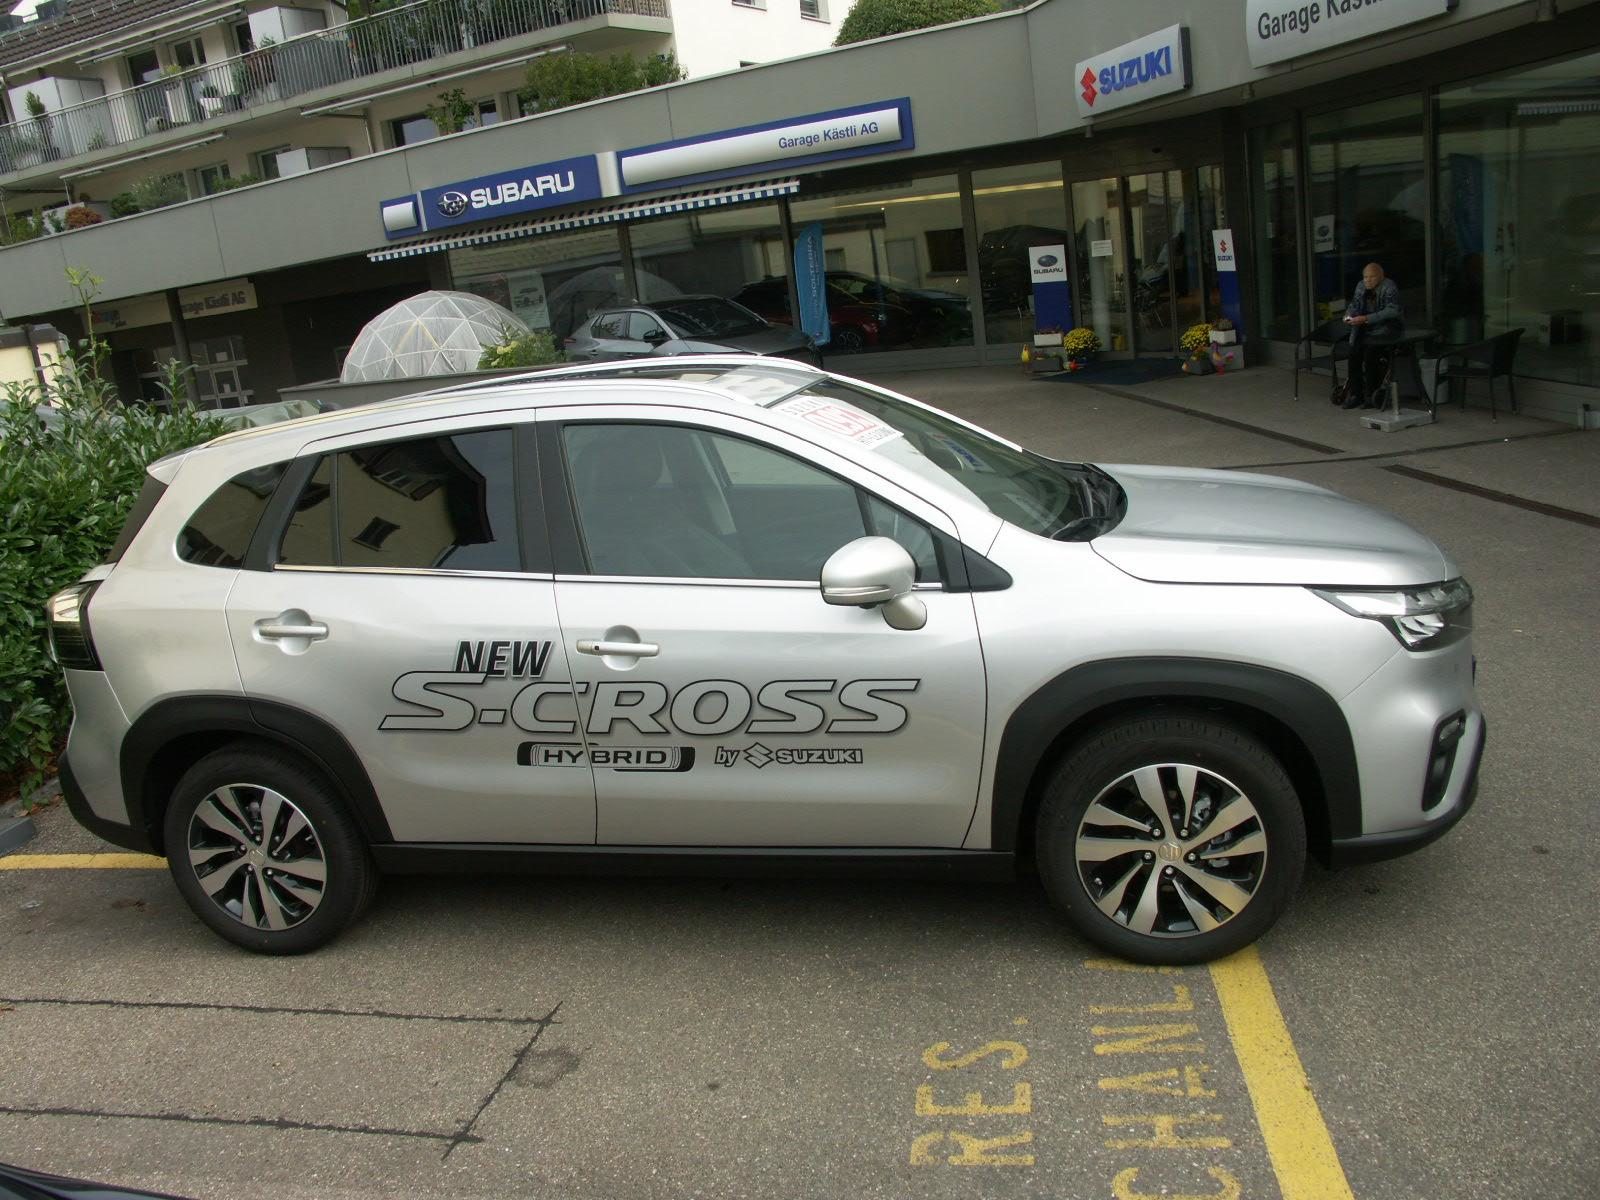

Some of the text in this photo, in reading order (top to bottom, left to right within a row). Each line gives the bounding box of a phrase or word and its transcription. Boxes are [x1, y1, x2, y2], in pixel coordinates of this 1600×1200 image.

[1257, 1, 1321, 40] Garage
[1098, 45, 1172, 95] SUZUKI
[778, 121, 879, 149] Garage Kästli AG
[470, 170, 575, 209] SUBARU
[1033, 267, 1064, 275] SUBARU
[455, 640, 552, 677] NEW
[543, 749, 667, 764] HYBRID
[714, 746, 863, 767] by SUZUKI
